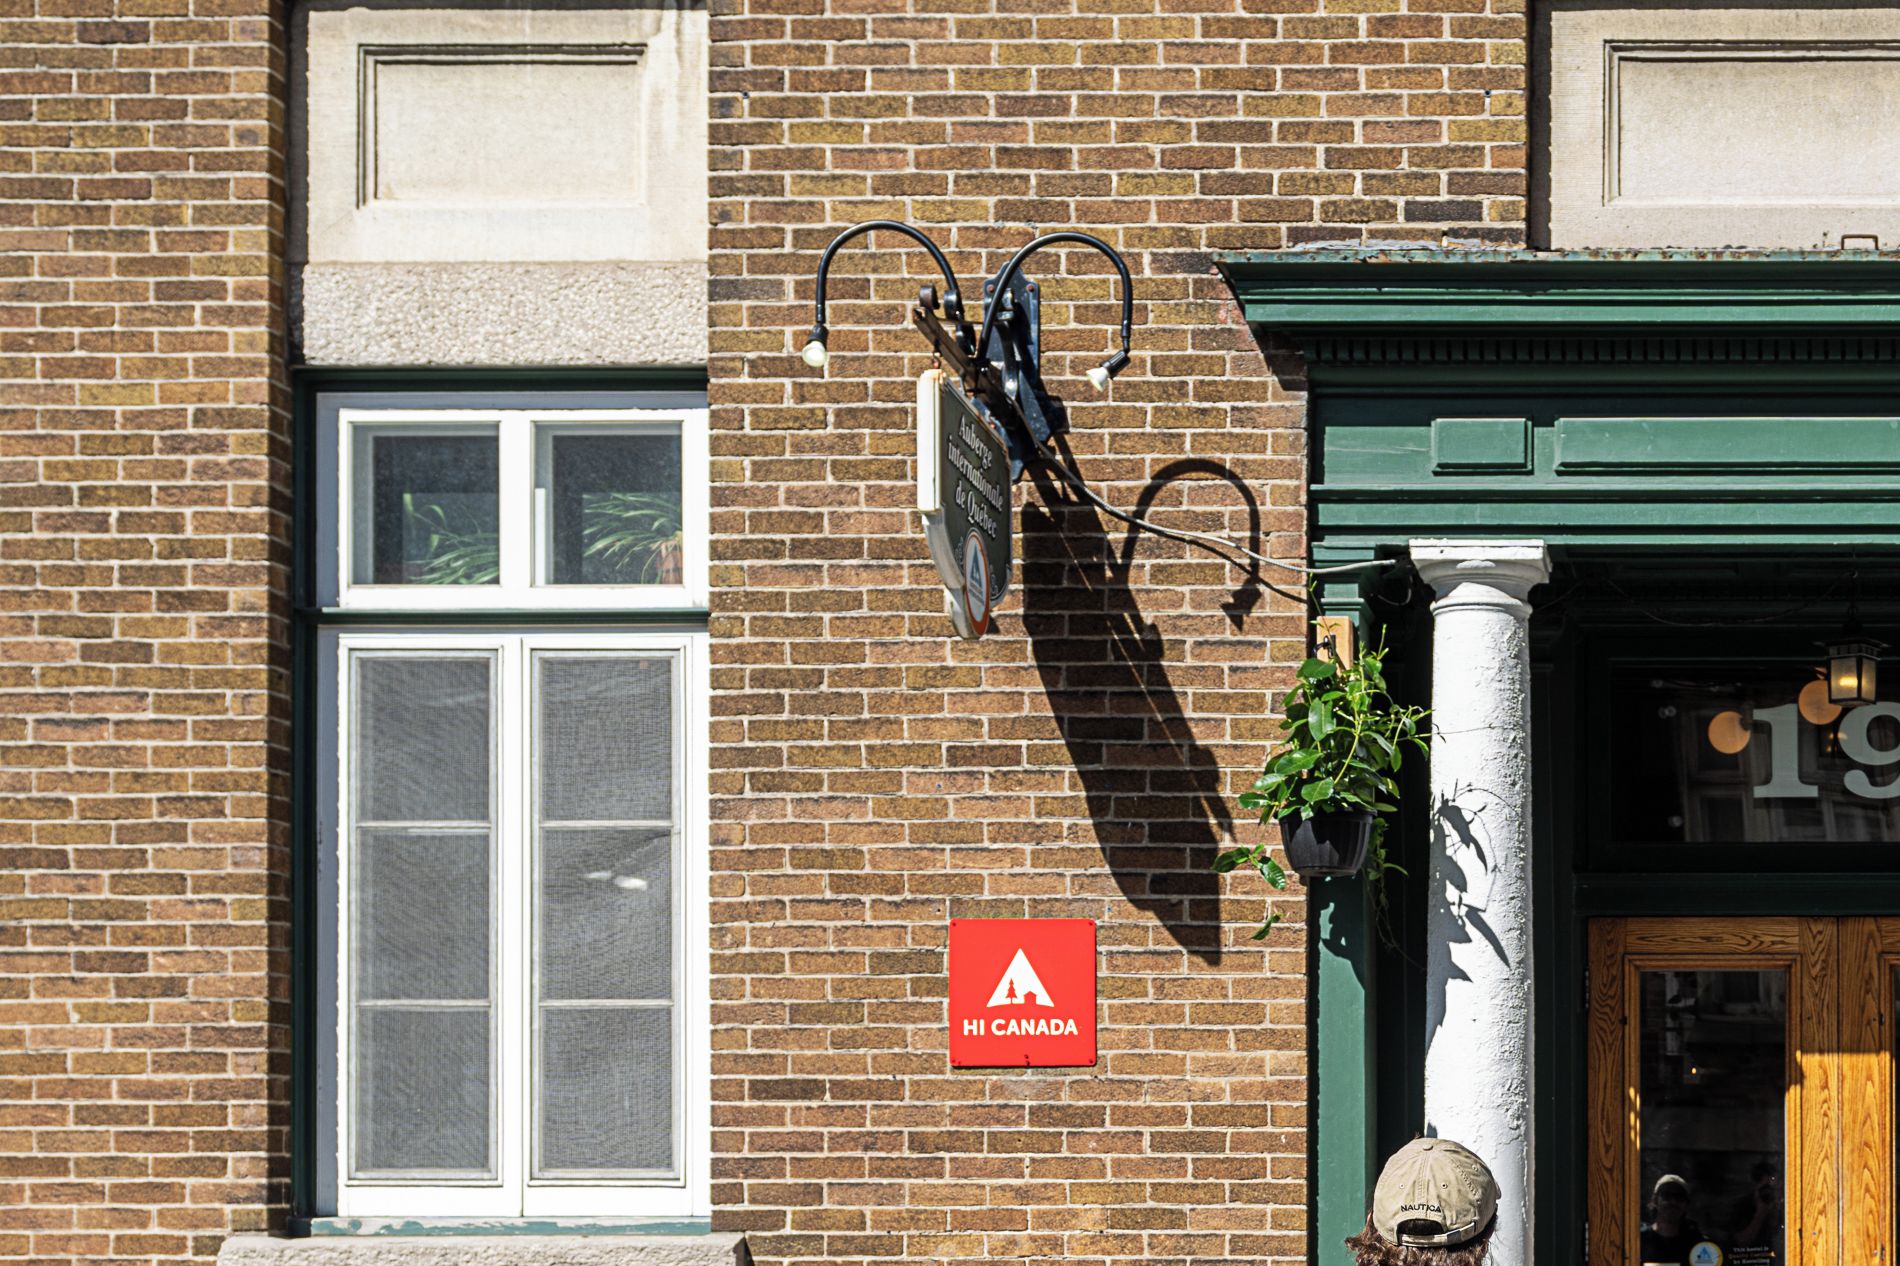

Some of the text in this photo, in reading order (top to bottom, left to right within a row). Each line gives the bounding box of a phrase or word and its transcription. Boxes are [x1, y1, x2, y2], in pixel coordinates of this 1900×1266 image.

[958, 414, 992, 470] Auberge
[947, 435, 1004, 512] internationale
[955, 479, 997, 539] de Québec
[963, 1018, 1078, 1036] HI CANADA
[1401, 1203, 1442, 1213] NAUTICA
